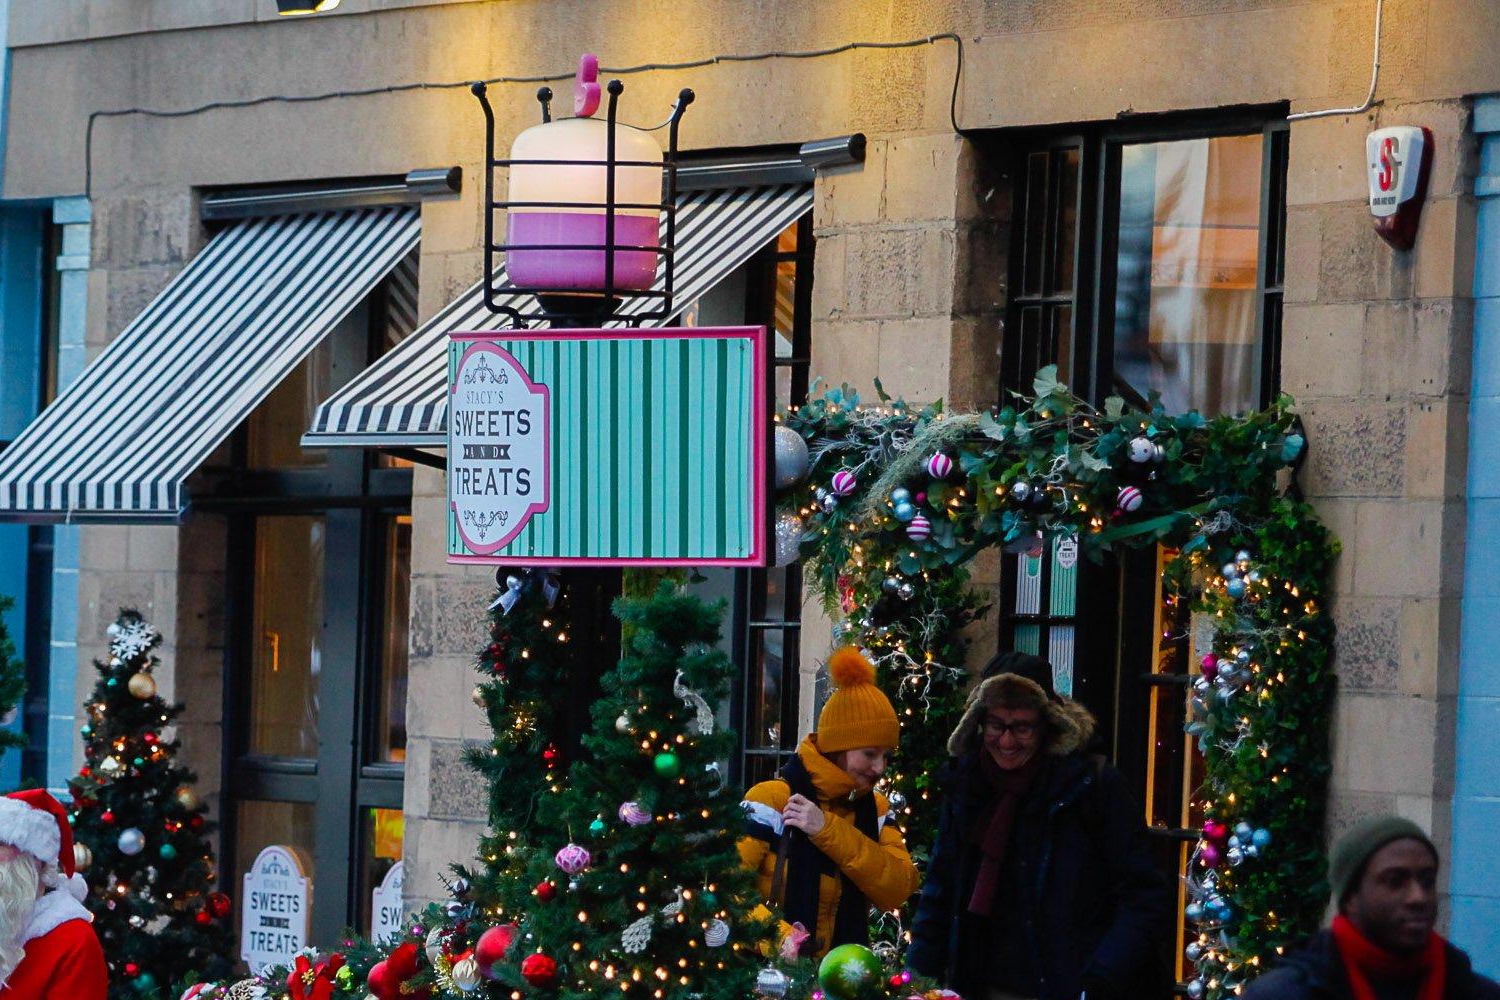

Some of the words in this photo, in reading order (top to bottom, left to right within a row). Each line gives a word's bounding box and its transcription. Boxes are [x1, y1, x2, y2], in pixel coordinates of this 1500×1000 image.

[466, 390, 504, 405] STACY'S
[455, 409, 531, 437] SWEETS
[470, 446, 499, 458] AND
[455, 468, 531, 496] TREATS
[251, 891, 300, 913] SWEETS
[250, 931, 299, 955] TREATS
